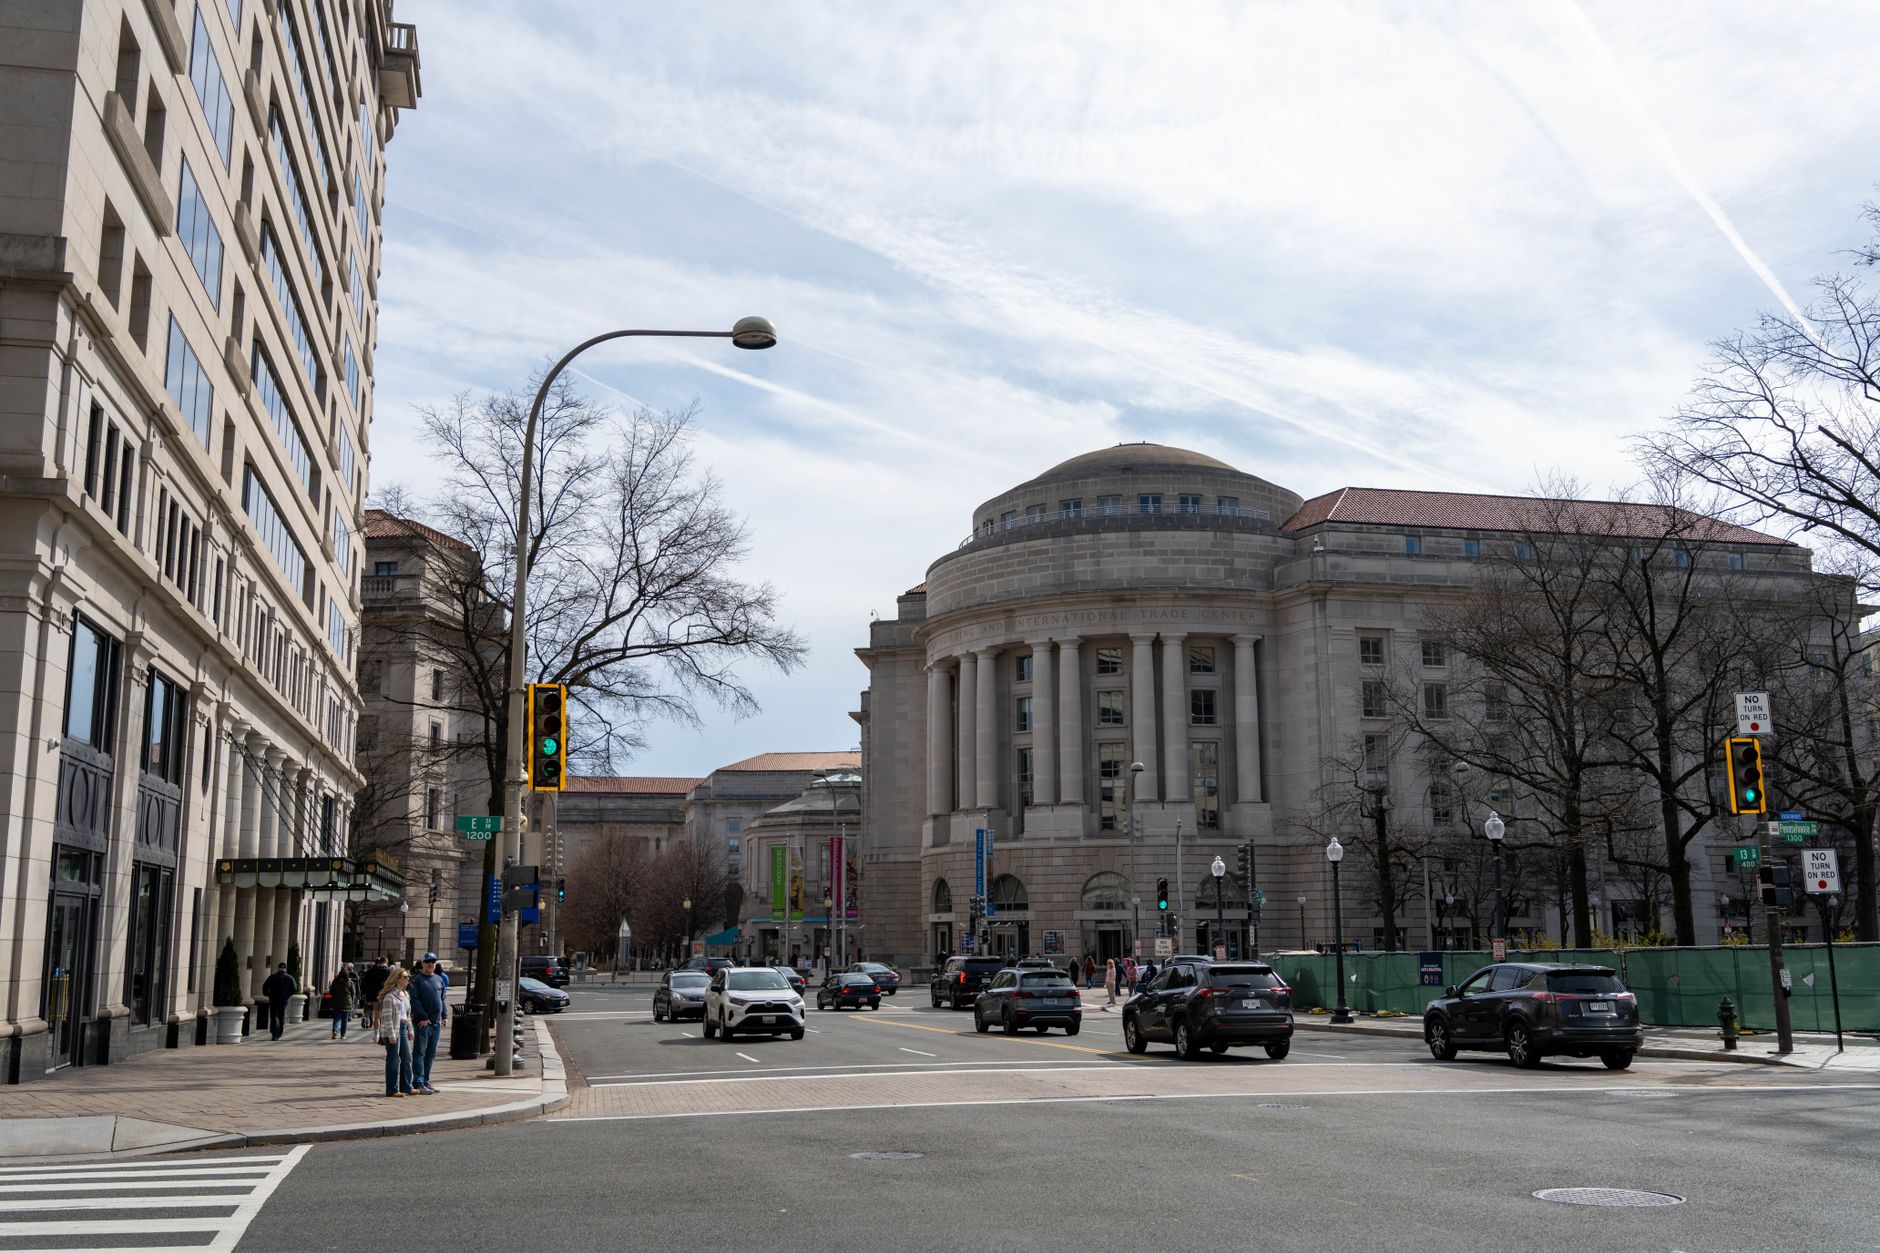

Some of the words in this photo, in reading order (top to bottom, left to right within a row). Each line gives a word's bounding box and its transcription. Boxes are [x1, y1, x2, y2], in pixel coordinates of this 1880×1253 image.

[983, 622, 1003, 634] AND
[1140, 609, 1188, 619] TRADE
[1201, 609, 1256, 621] CENTER
[1744, 695, 1759, 704] NO
[471, 817, 477, 829] E
[1779, 823, 1811, 834] Pennsylvania
[466, 831, 492, 840] 1200
[1787, 834, 1803, 842] 1300
[1739, 849, 1748, 860] 13
[1812, 852, 1826, 861] NO
[1811, 862, 1830, 870] TURN
